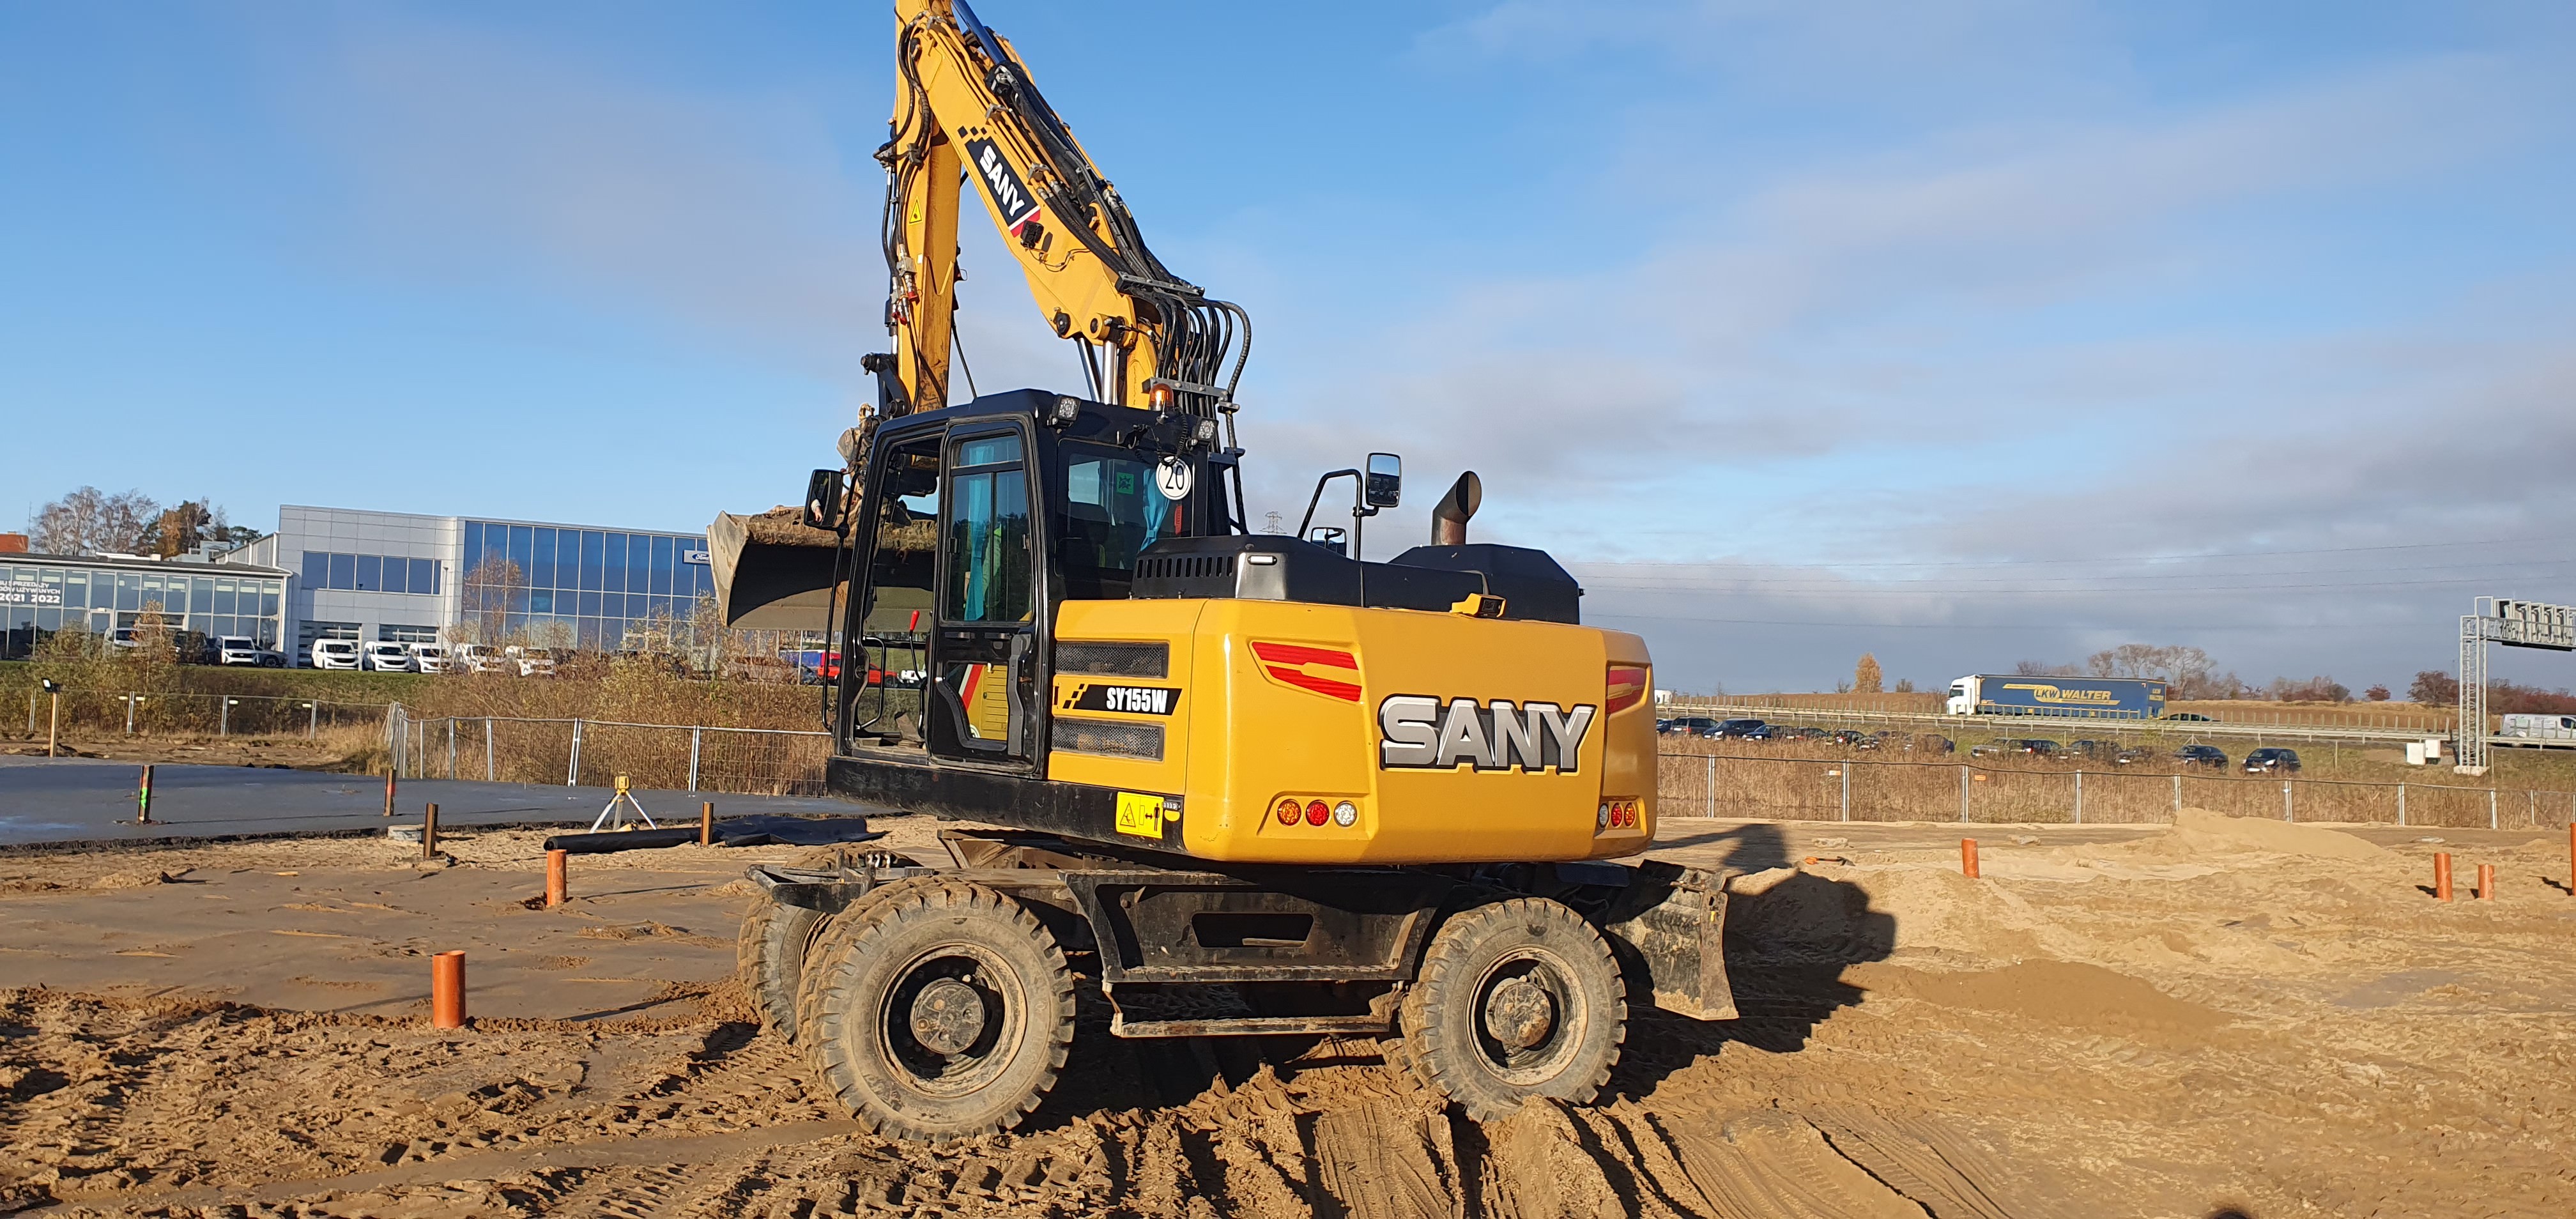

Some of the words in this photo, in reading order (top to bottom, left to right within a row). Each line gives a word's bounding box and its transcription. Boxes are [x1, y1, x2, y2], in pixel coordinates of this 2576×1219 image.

[979, 144, 1025, 217] SANY
[1165, 464, 1184, 490] 20
[0, 593, 26, 602] 2021
[31, 594, 61, 604] 2022
[1106, 687, 1168, 714] SY155W
[2035, 689, 2058, 698] LKW
[2062, 689, 2112, 700] WALTER
[1378, 694, 1597, 771] SANY
